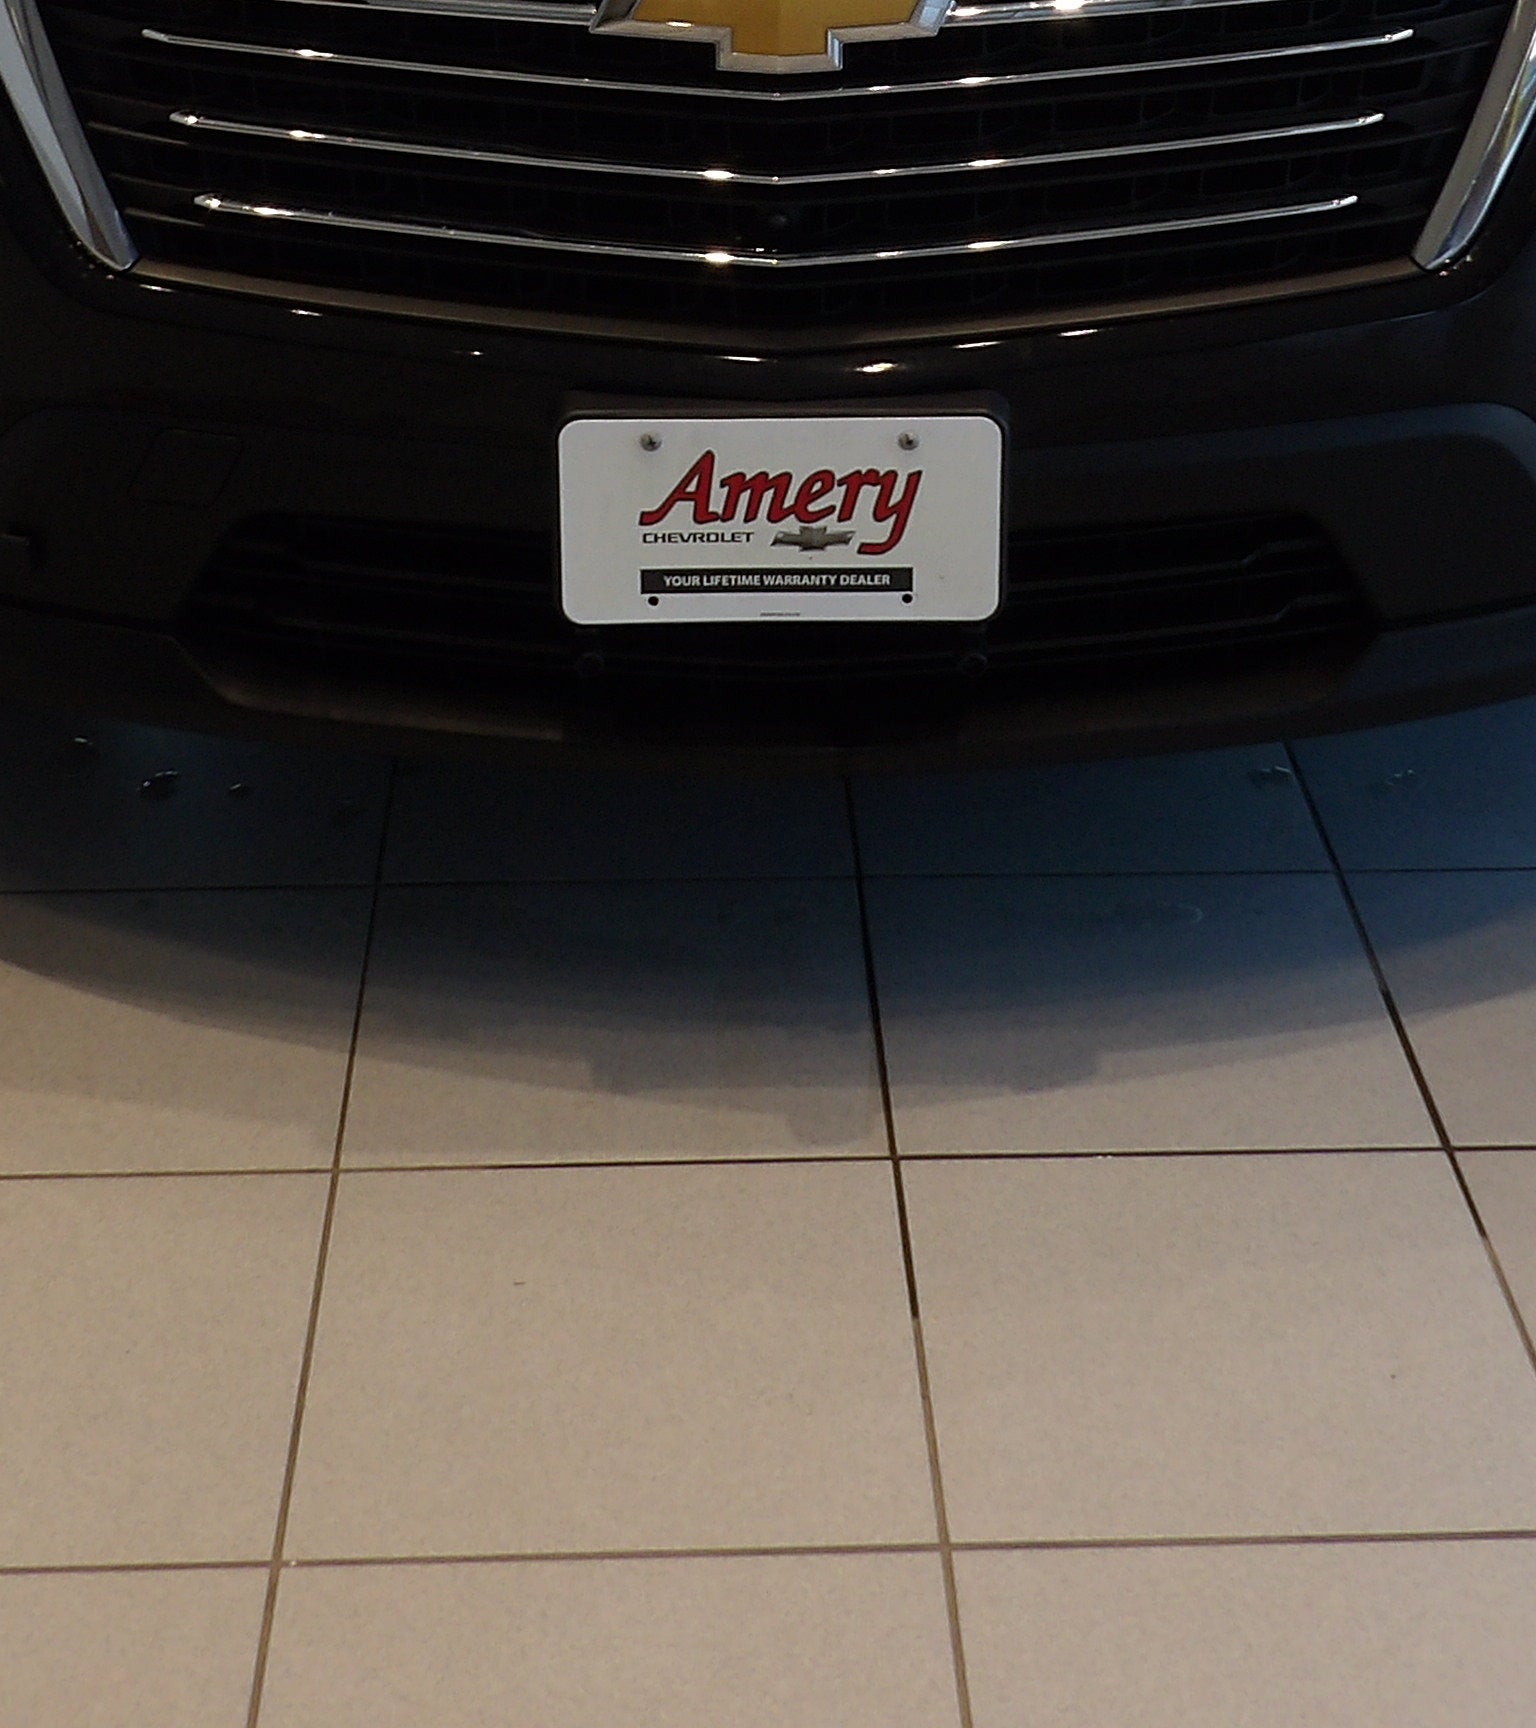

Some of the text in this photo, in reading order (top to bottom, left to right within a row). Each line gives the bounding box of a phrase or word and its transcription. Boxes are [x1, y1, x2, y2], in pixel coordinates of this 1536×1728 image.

[638, 449, 924, 556] Amery
[642, 531, 755, 544] CHEVROLET
[664, 573, 891, 587] YOUR LIFETIME WARRANTY DEALER
